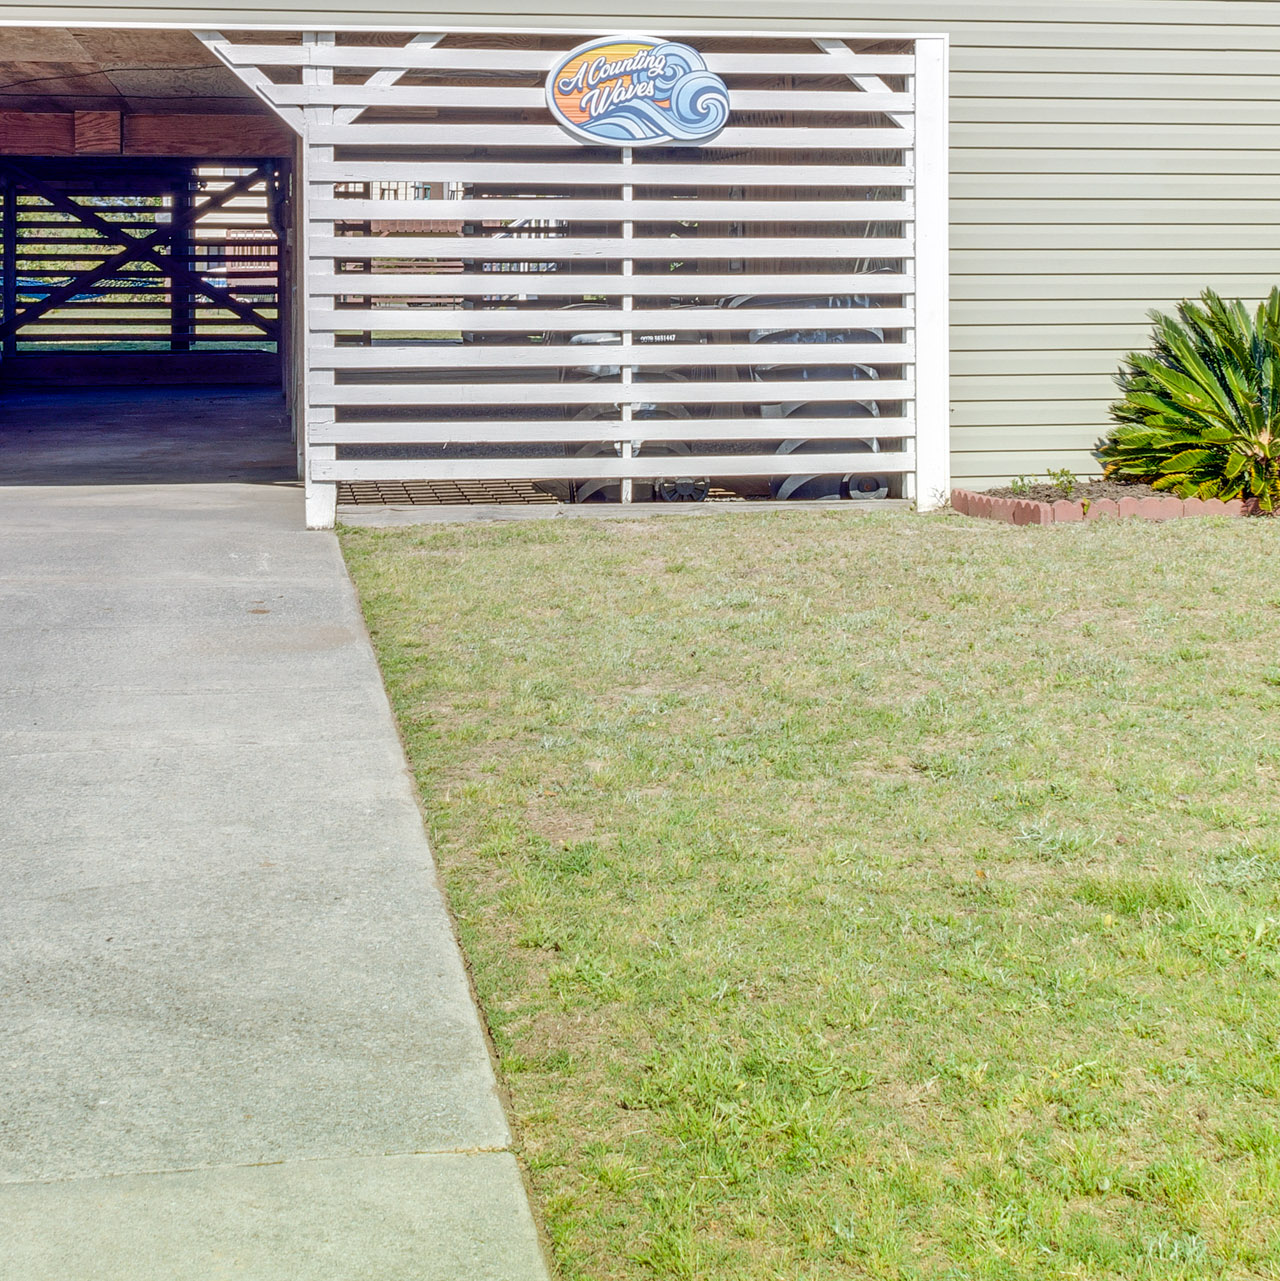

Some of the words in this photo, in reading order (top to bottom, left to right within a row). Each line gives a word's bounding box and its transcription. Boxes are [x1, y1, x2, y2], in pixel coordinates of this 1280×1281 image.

[559, 61, 588, 90] A
[587, 50, 666, 85] Counting
[581, 79, 654, 116] Waves
